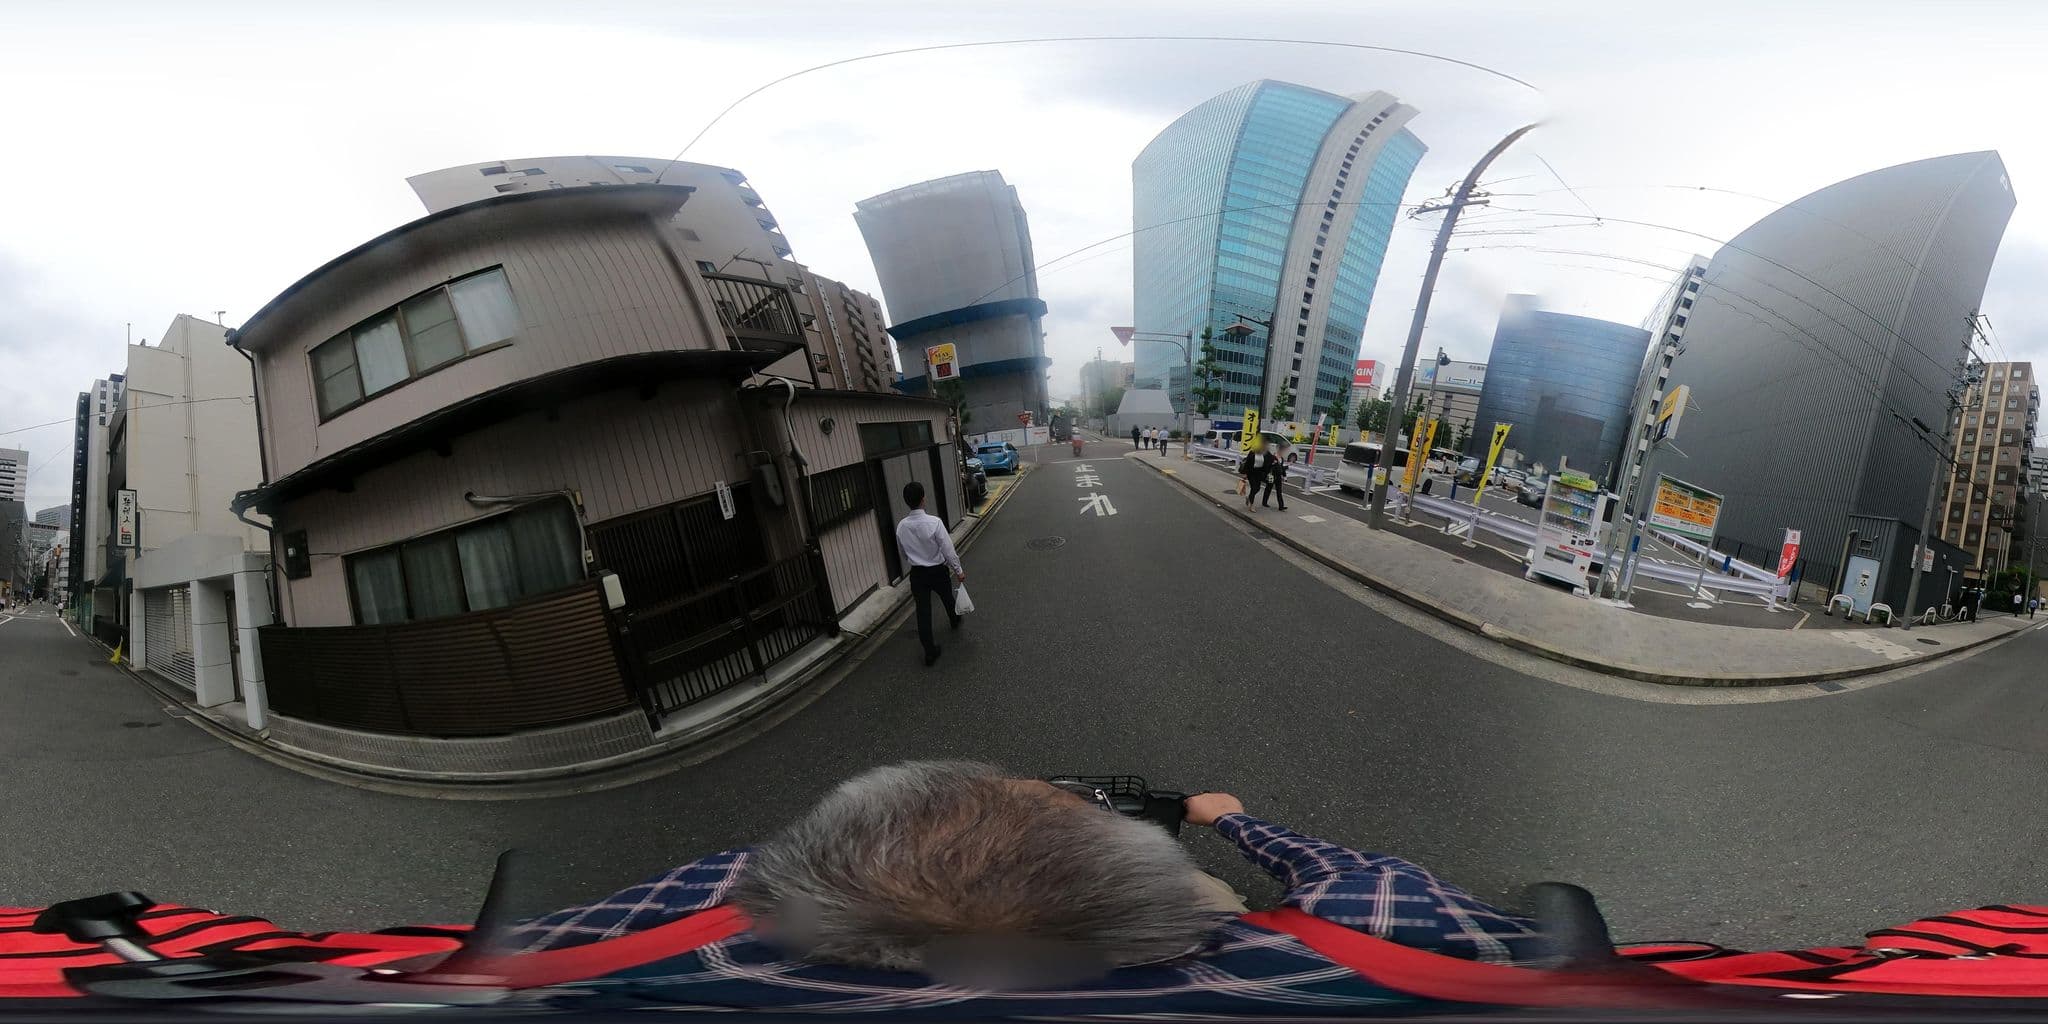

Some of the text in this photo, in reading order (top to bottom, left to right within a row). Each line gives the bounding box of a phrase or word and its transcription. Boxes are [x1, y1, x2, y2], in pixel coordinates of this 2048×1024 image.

[1242, 412, 1256, 452] オープン
[1074, 463, 1118, 517] 止まれ
